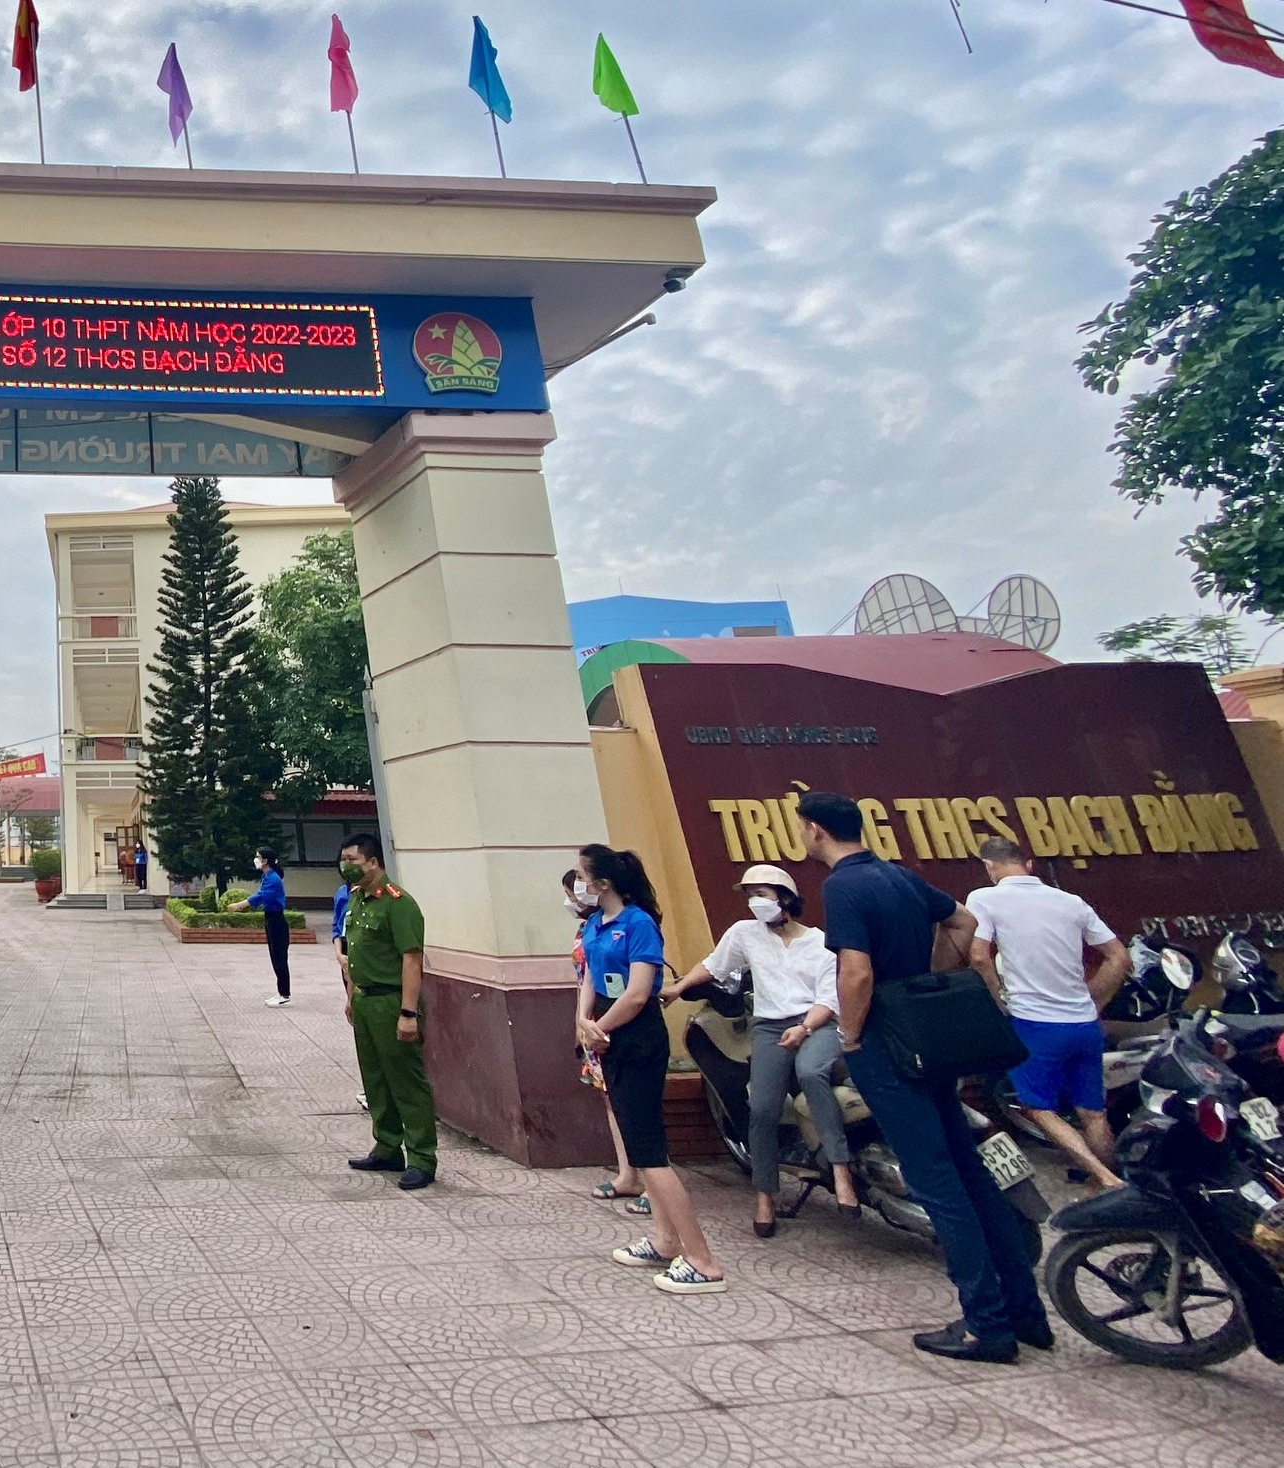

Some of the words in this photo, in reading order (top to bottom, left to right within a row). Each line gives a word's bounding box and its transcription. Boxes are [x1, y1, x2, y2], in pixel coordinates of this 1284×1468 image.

[42, 317, 66, 339] 10
[72, 319, 131, 341] THPT
[137, 316, 189, 342] NĂM
[195, 322, 247, 347] HỌC
[251, 323, 357, 346] 2022-2023
[2, 339, 38, 367] SỐ
[42, 346, 66, 368] 12
[73, 347, 136, 370] THCS
[142, 349, 210, 375] BẠCH
[709, 780, 903, 862] TRƯG
[1014, 795, 1143, 869] BẠCH
